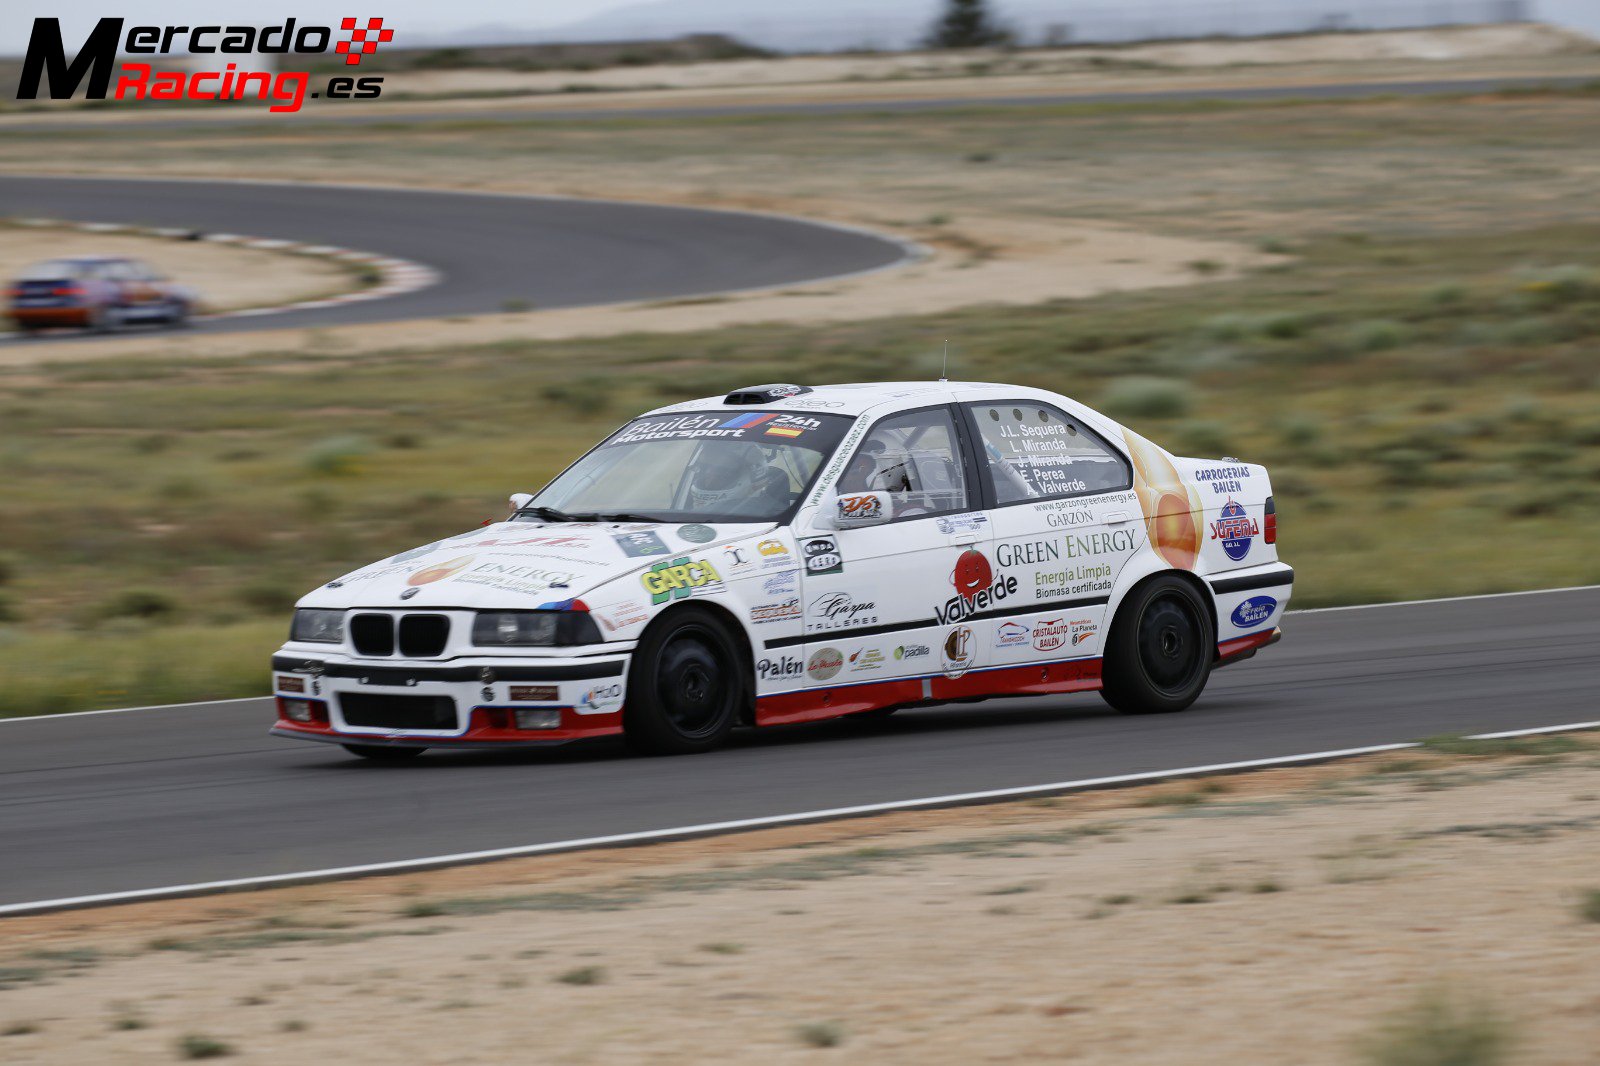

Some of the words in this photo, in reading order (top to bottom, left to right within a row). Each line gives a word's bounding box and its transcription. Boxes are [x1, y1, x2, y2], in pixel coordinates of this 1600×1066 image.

[774, 414, 821, 427] 24h
[611, 428, 746, 445] Motorsport
[1000, 425, 1020, 438] J.L.
[1021, 424, 1066, 438] Sequera
[1010, 440, 1022, 453] L.
[1023, 438, 1067, 451] Miranda
[1028, 454, 1073, 467] Miranda
[1020, 470, 1033, 482] E.
[1033, 469, 1065, 481] Perea
[1038, 479, 1087, 494] Valverde
[1034, 492, 1137, 511] www.garzongreenenergy.es
[1046, 509, 1094, 527] GARZÓN
[996, 539, 1059, 567] GREEN
[1065, 529, 1136, 558] ENERGY
[1035, 567, 1074, 586] Energía
[1076, 563, 1111, 580] Limpia
[1036, 585, 1070, 599] Biomasa
[1071, 579, 1112, 593] certificada
[934, 574, 1018, 626] Valverde
[807, 616, 879, 631] TALLERES
[1032, 625, 1068, 638] CRISTALAUTO
[756, 656, 804, 680] Palén
